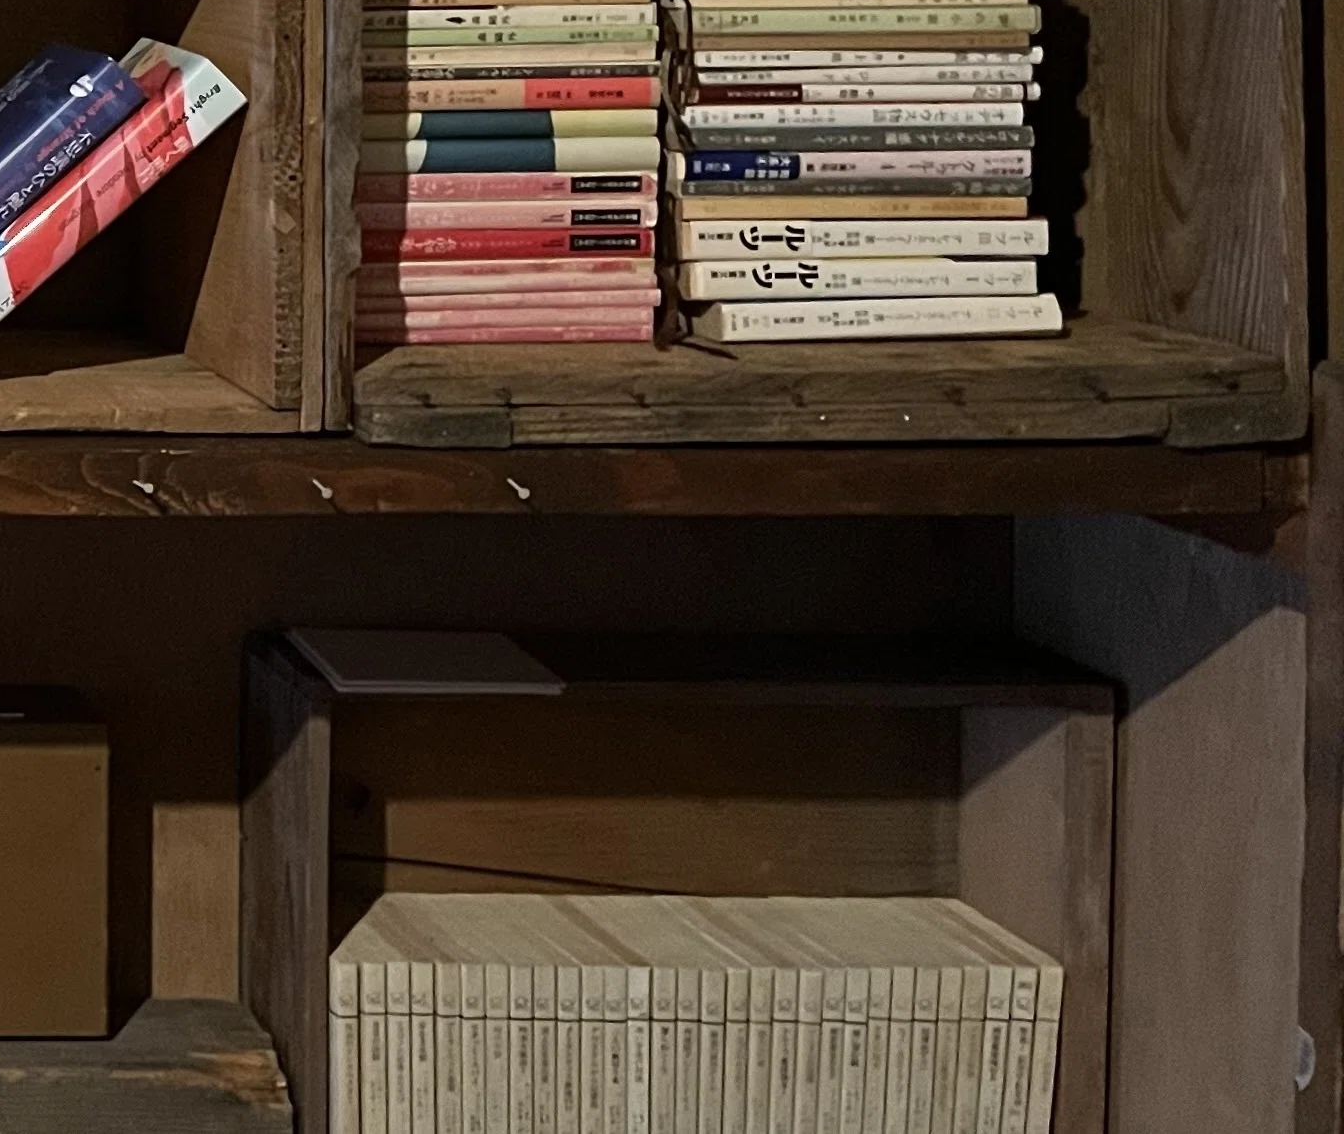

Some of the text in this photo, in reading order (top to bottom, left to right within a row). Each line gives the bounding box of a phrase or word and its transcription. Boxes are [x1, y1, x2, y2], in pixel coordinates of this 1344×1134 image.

[190, 83, 221, 116] Bright
[739, 225, 806, 252] ルーツ
[751, 262, 819, 289] ルーツ
